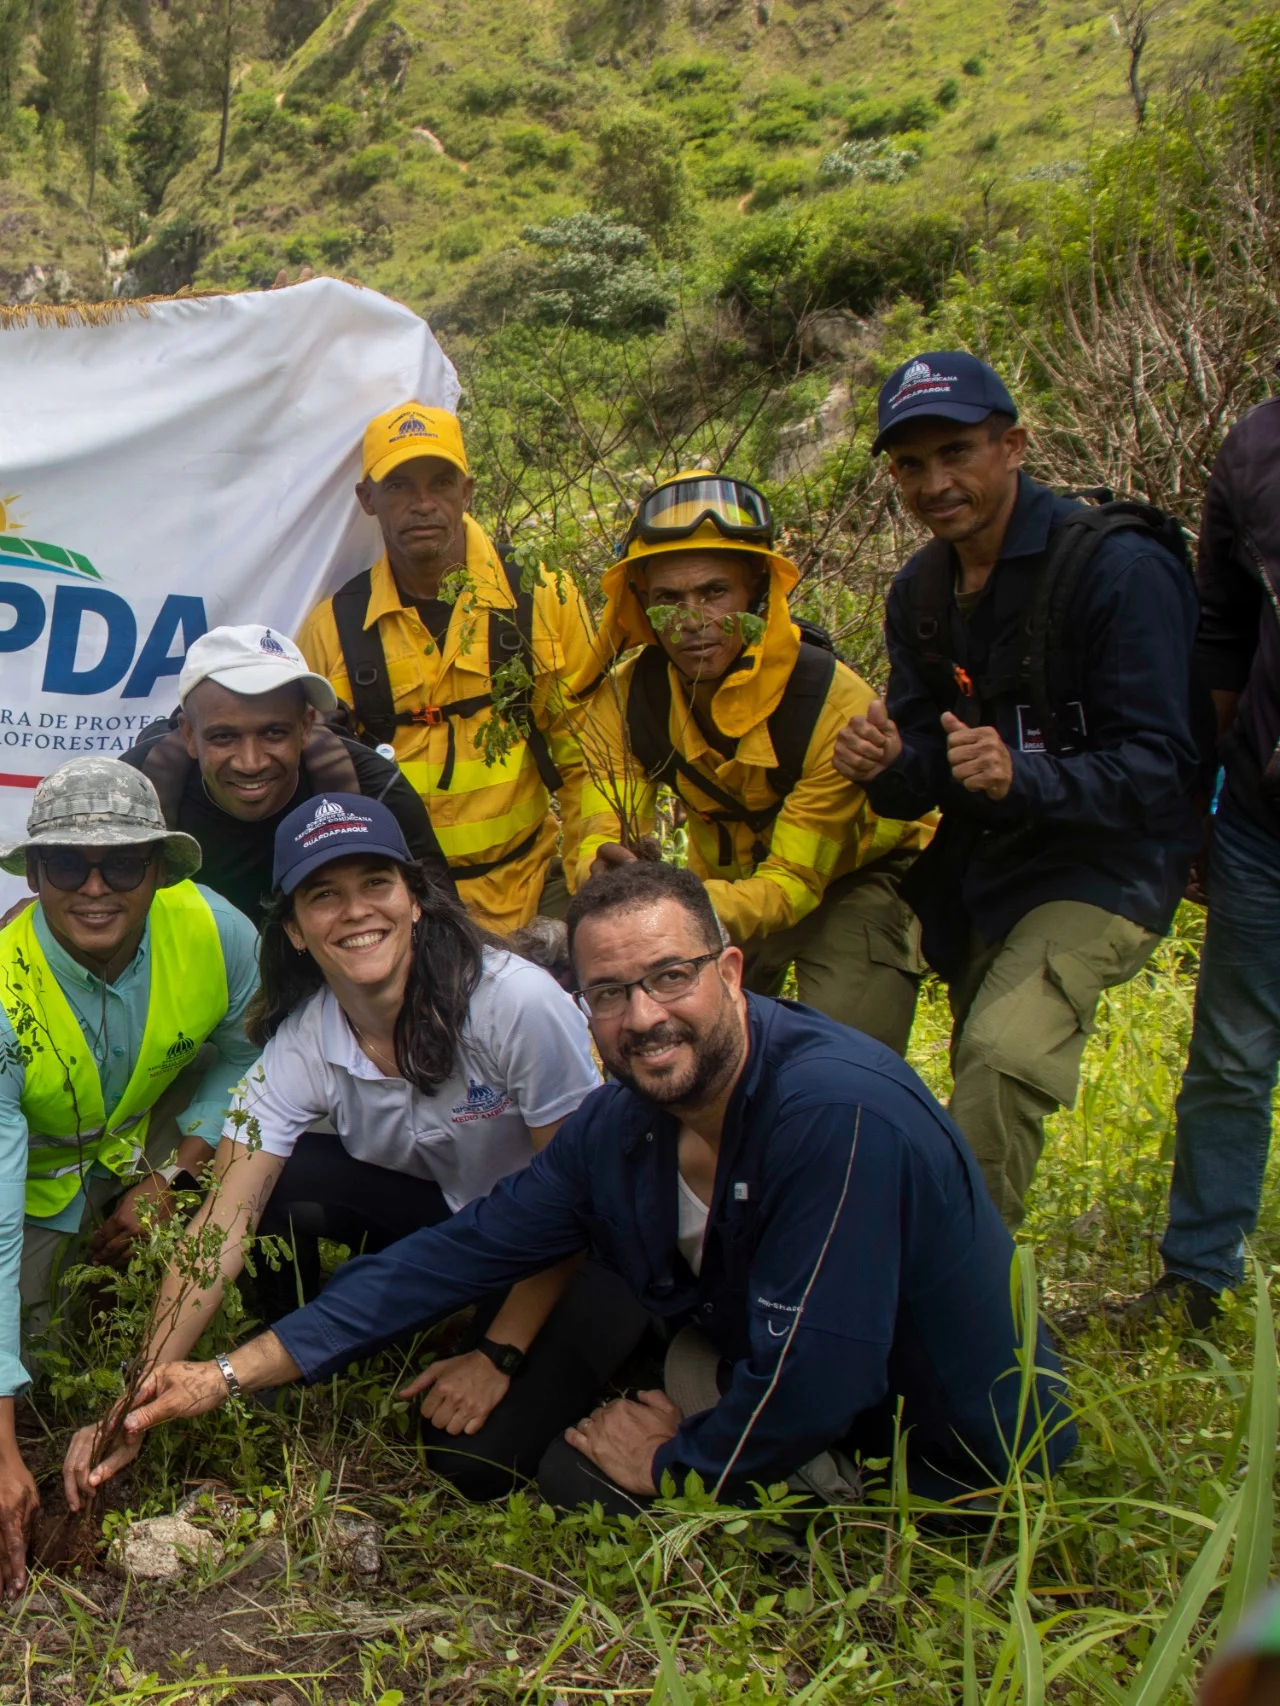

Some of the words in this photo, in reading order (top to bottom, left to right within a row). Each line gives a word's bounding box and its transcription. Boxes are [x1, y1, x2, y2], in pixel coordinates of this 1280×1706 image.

[39, 712, 68, 729] DE
[75, 715, 166, 731] PROYE
[303, 826, 369, 848] GUARDAPARQUE
